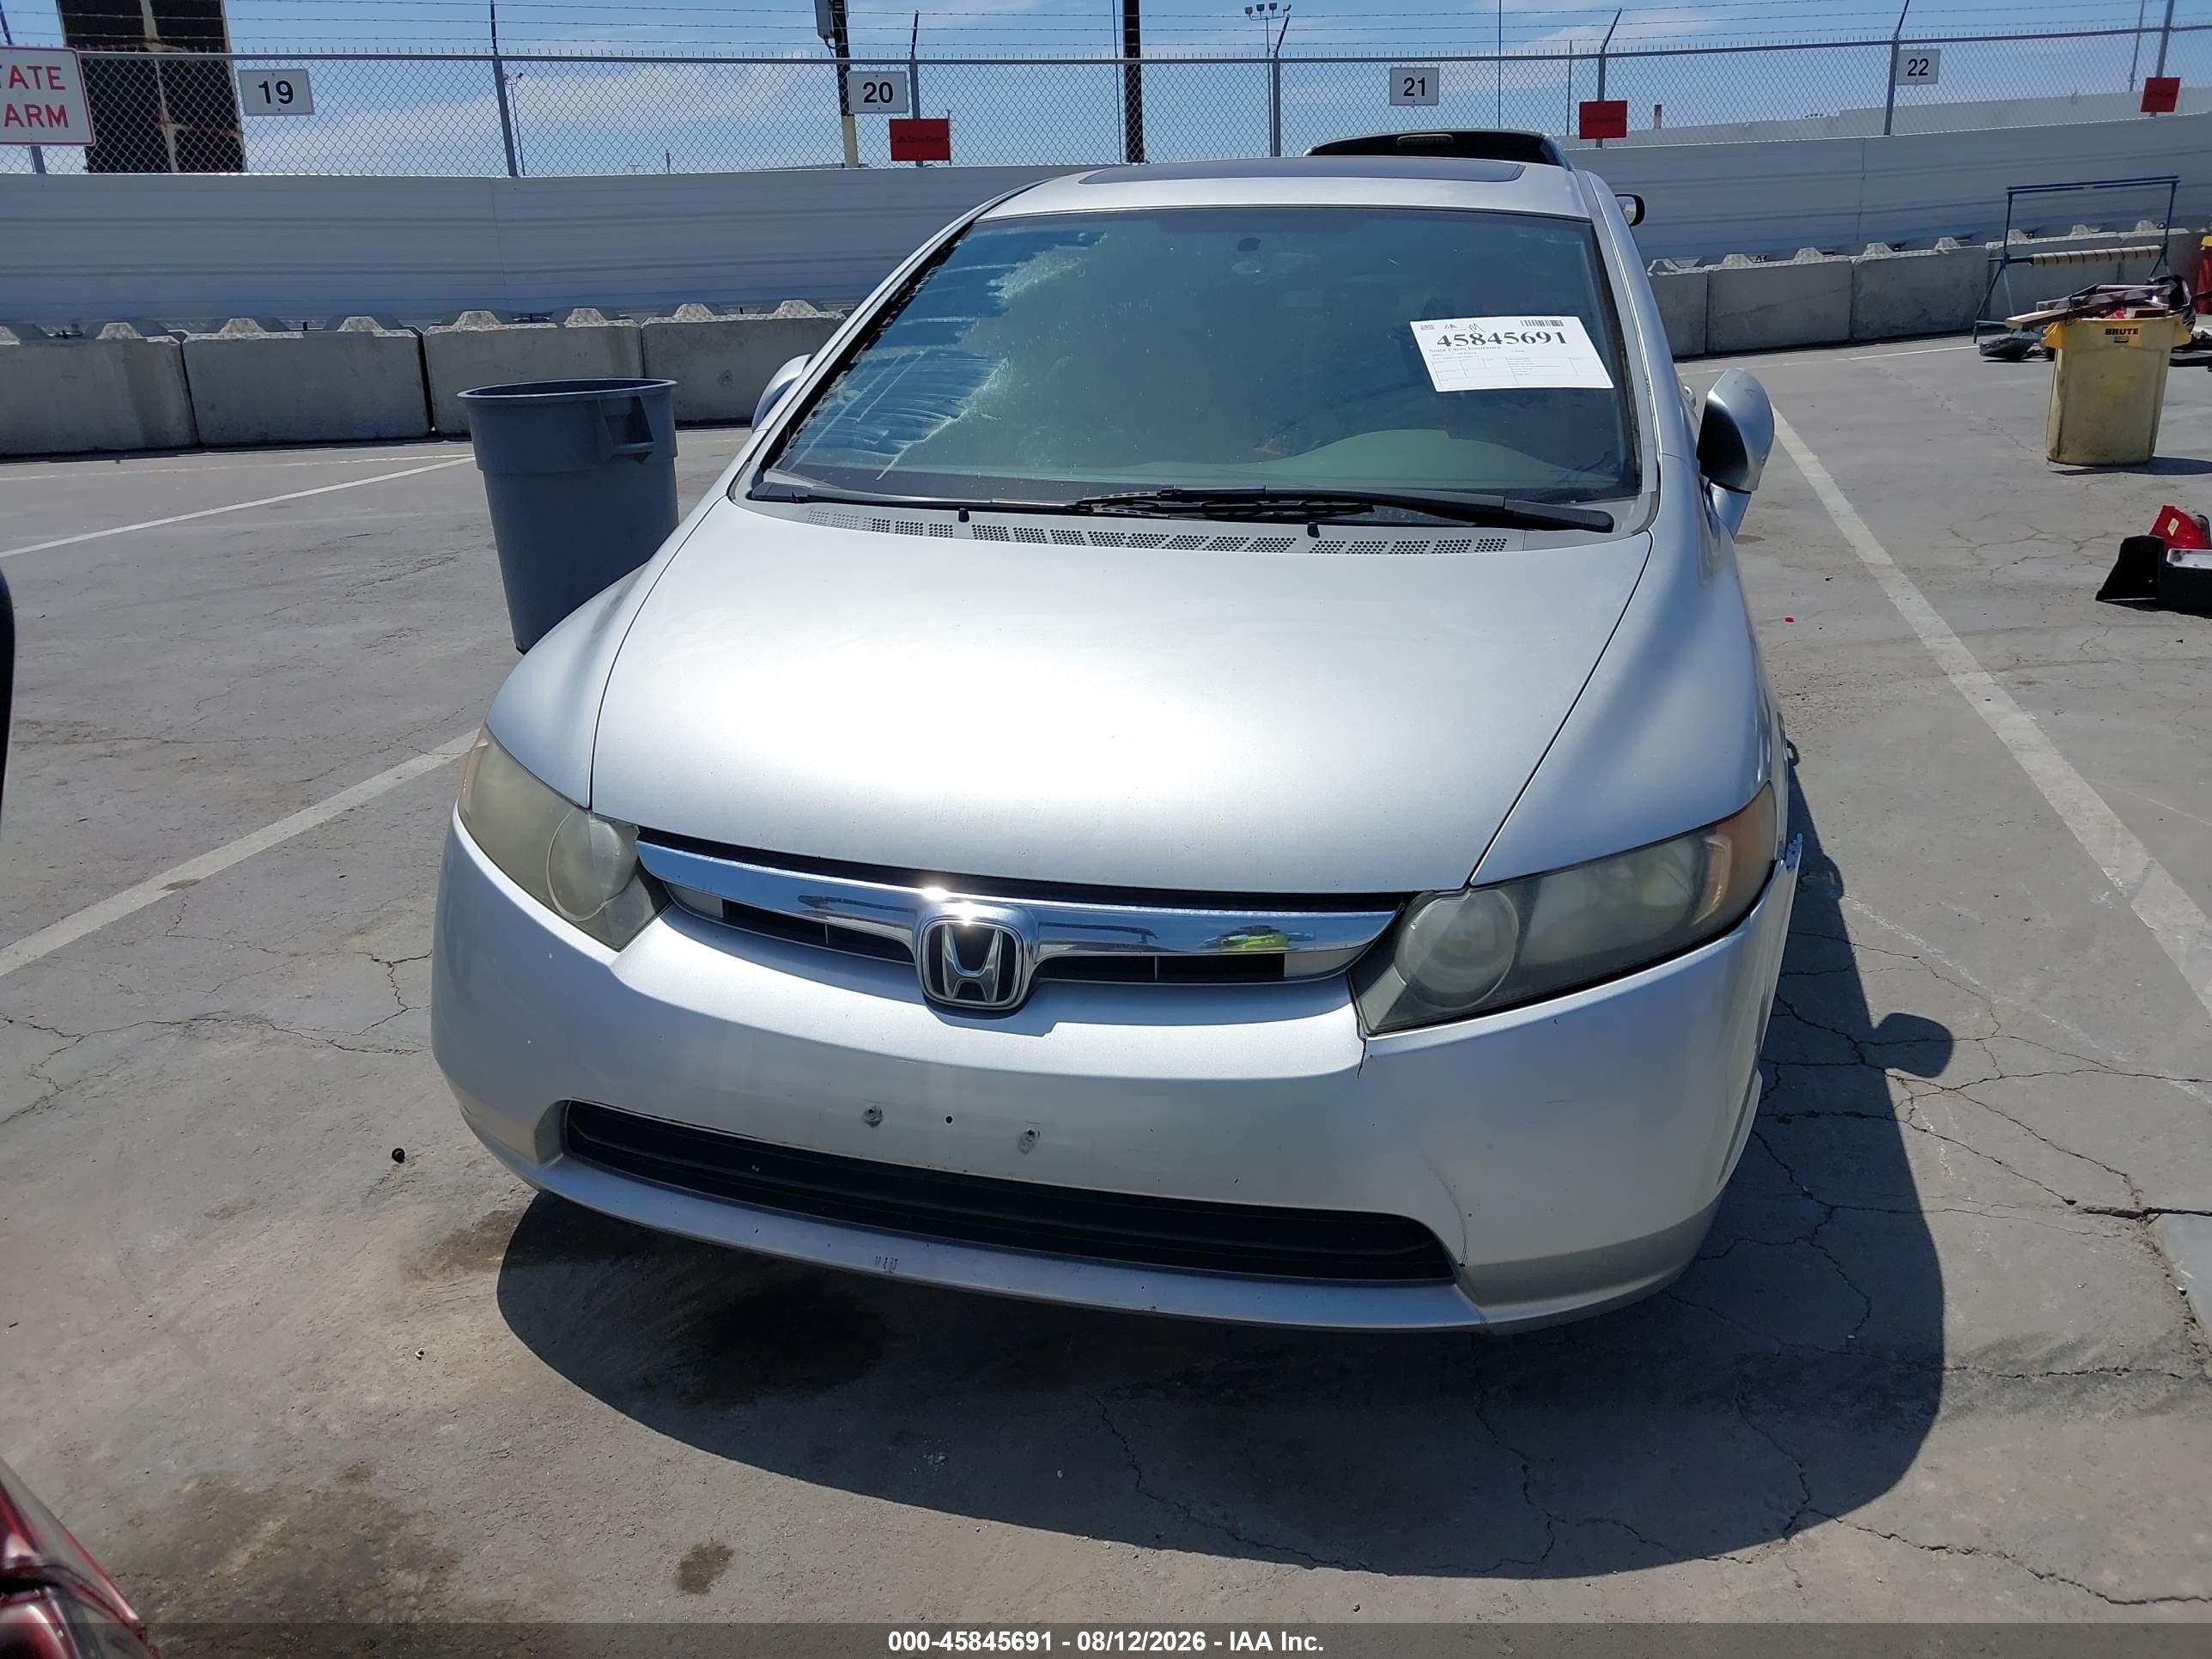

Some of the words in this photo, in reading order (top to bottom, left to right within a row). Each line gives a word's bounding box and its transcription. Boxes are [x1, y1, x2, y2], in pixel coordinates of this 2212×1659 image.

[0, 64, 66, 90] ATE
[1906, 58, 1929, 76] 22
[258, 80, 294, 105] 19
[862, 82, 894, 104] 20
[1402, 76, 1425, 97] 21
[1437, 331, 1567, 347] 45845691
